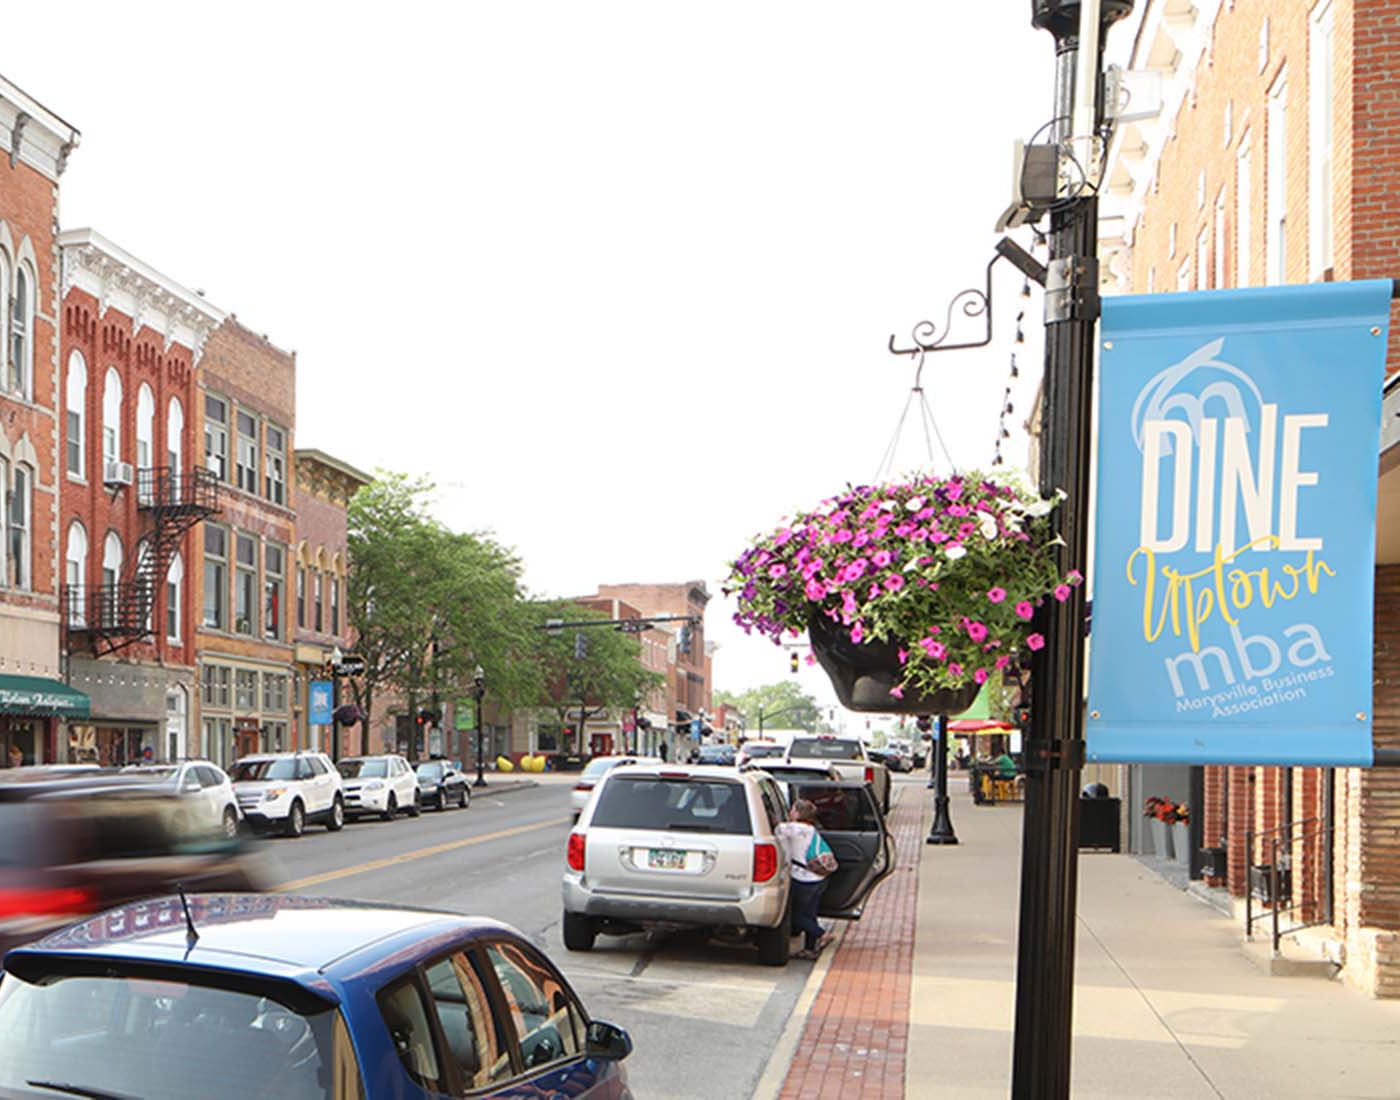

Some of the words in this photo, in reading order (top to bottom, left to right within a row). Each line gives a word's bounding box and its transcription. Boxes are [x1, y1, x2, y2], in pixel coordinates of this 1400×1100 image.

[1140, 403, 1329, 564] DINE
[1127, 535, 1337, 653] Uptown
[1164, 623, 1332, 698] mba
[1176, 683, 1258, 712] Marysville
[1262, 665, 1335, 692] Business
[1212, 686, 1306, 718] Association
